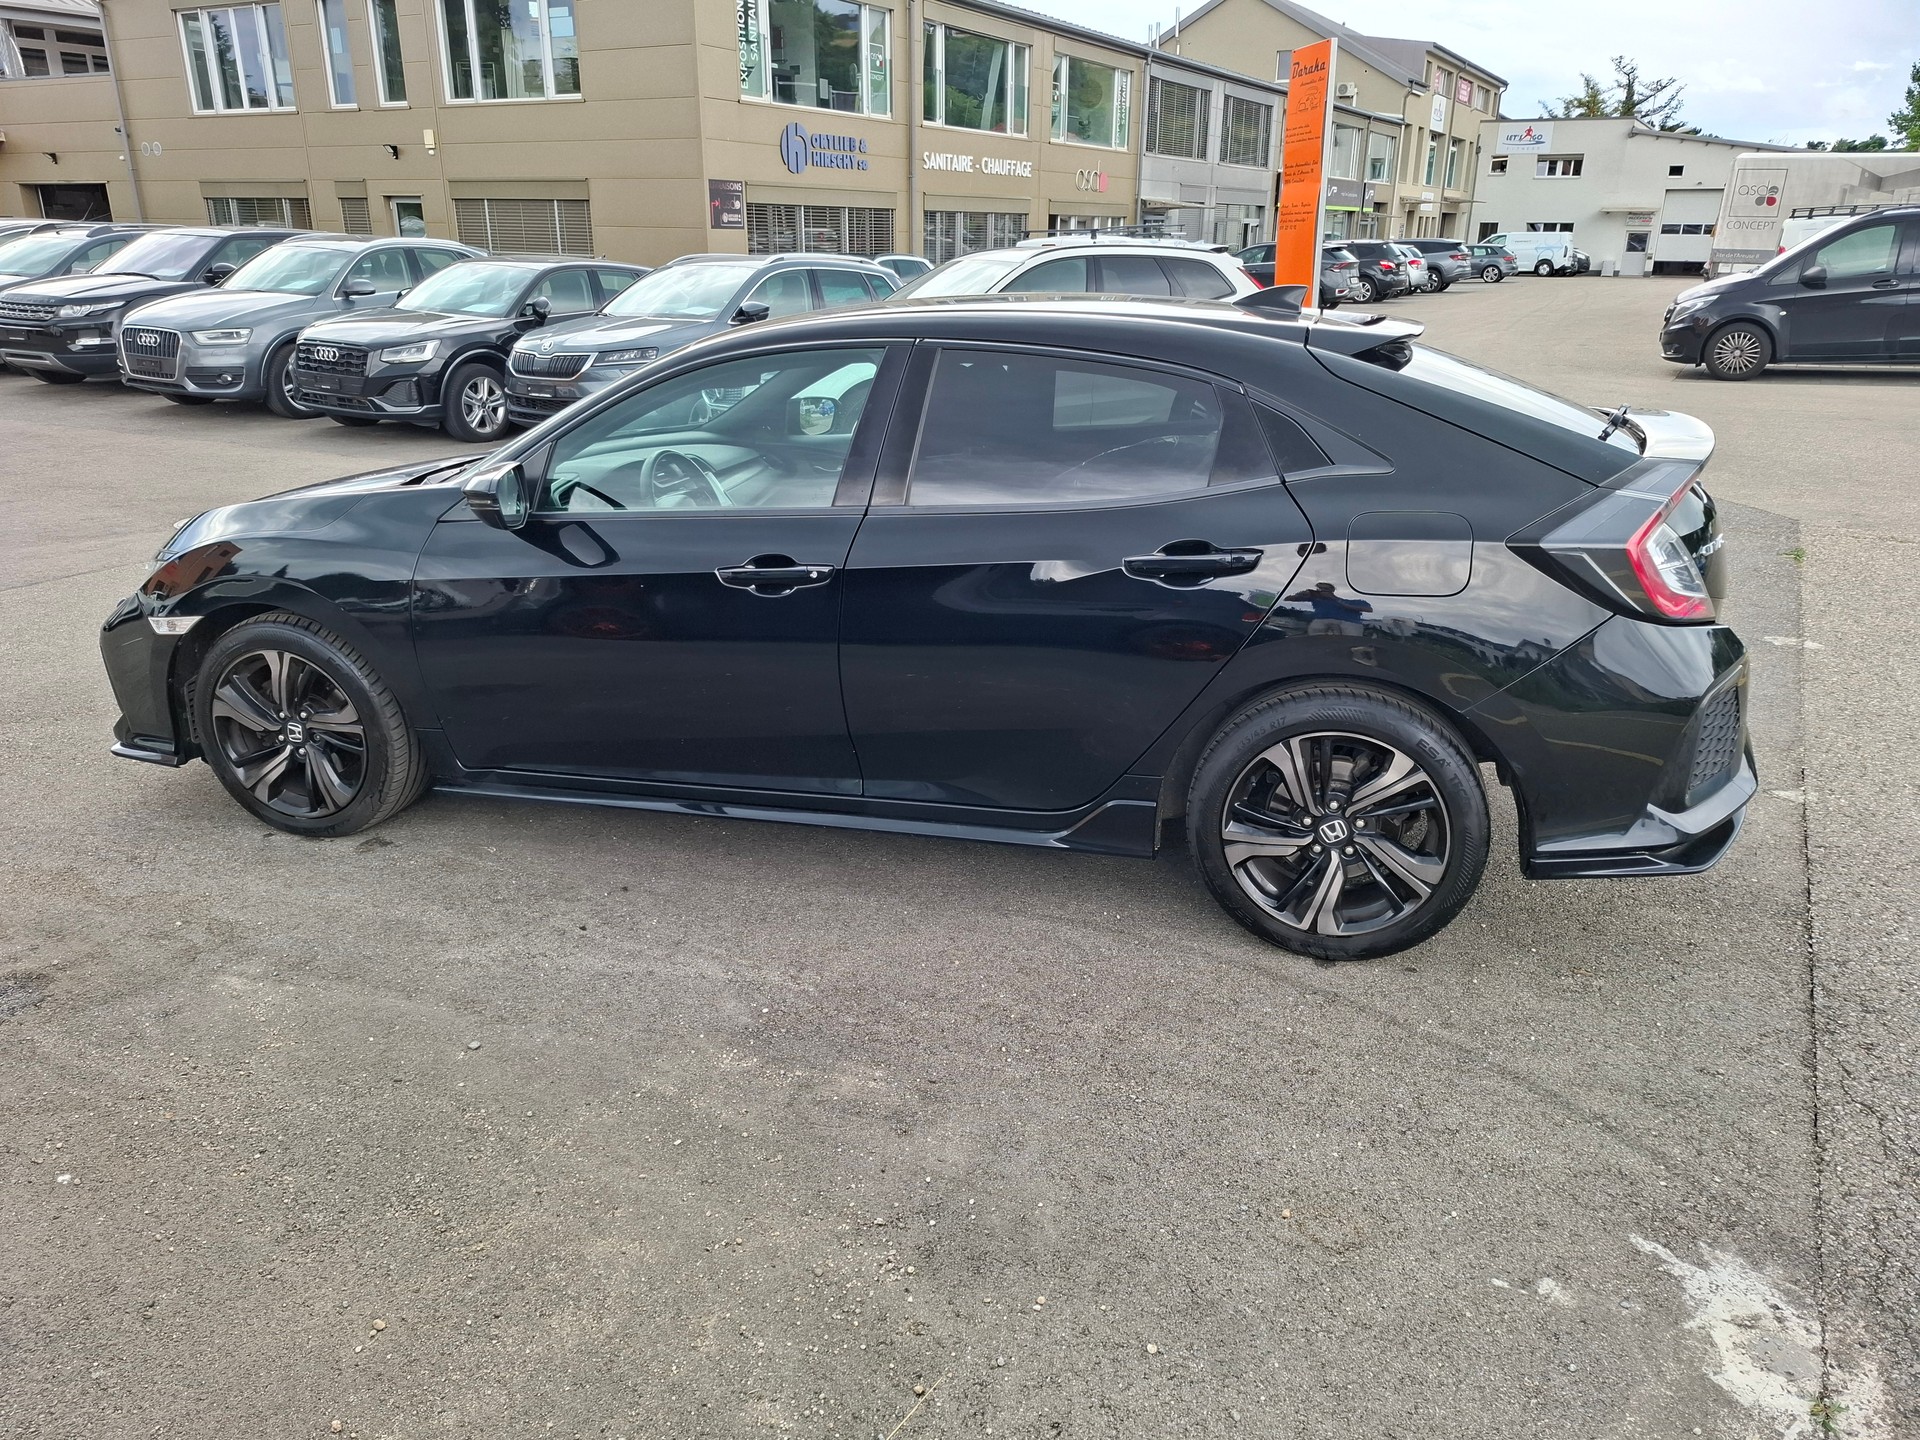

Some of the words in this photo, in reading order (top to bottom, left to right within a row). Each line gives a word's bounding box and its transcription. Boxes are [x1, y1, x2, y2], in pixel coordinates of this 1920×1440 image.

[737, 0, 749, 89] EXPOSITION
[811, 151, 857, 169] HIRSCHY
[922, 151, 973, 173] SANITAIRE
[981, 157, 1032, 178] CHAUFFAGE
[1726, 220, 1777, 230] CONCEPT
